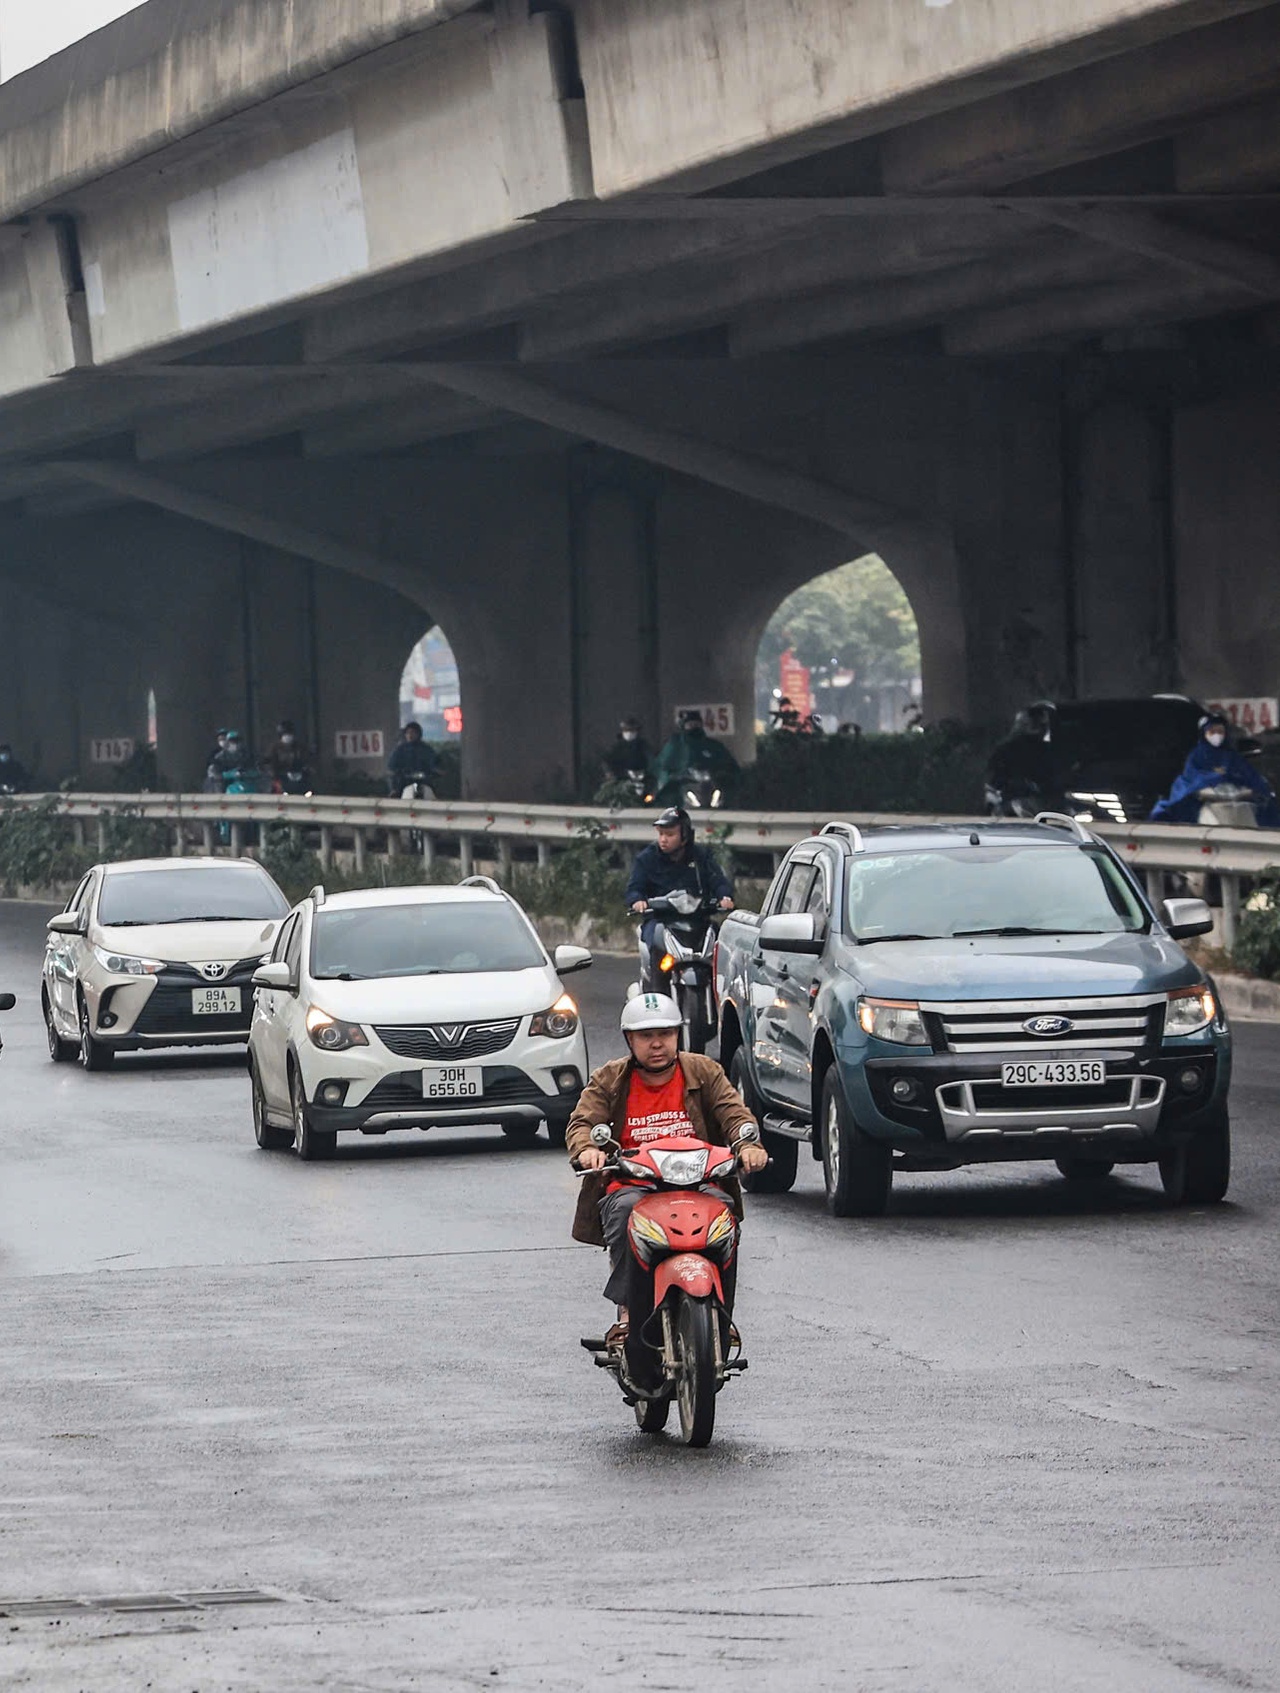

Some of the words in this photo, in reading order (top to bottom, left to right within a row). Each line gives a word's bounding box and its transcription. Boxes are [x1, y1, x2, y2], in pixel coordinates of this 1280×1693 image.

[206, 991, 227, 1001] 89A
[198, 1001, 236, 1013] 299.12
[1034, 1018, 1063, 1031] Ford
[440, 1069, 465, 1081] 30H
[1005, 1063, 1101, 1084] 29C-433.56
[429, 1082, 477, 1096] 655.60
[646, 1111, 678, 1123] STRAUSS
